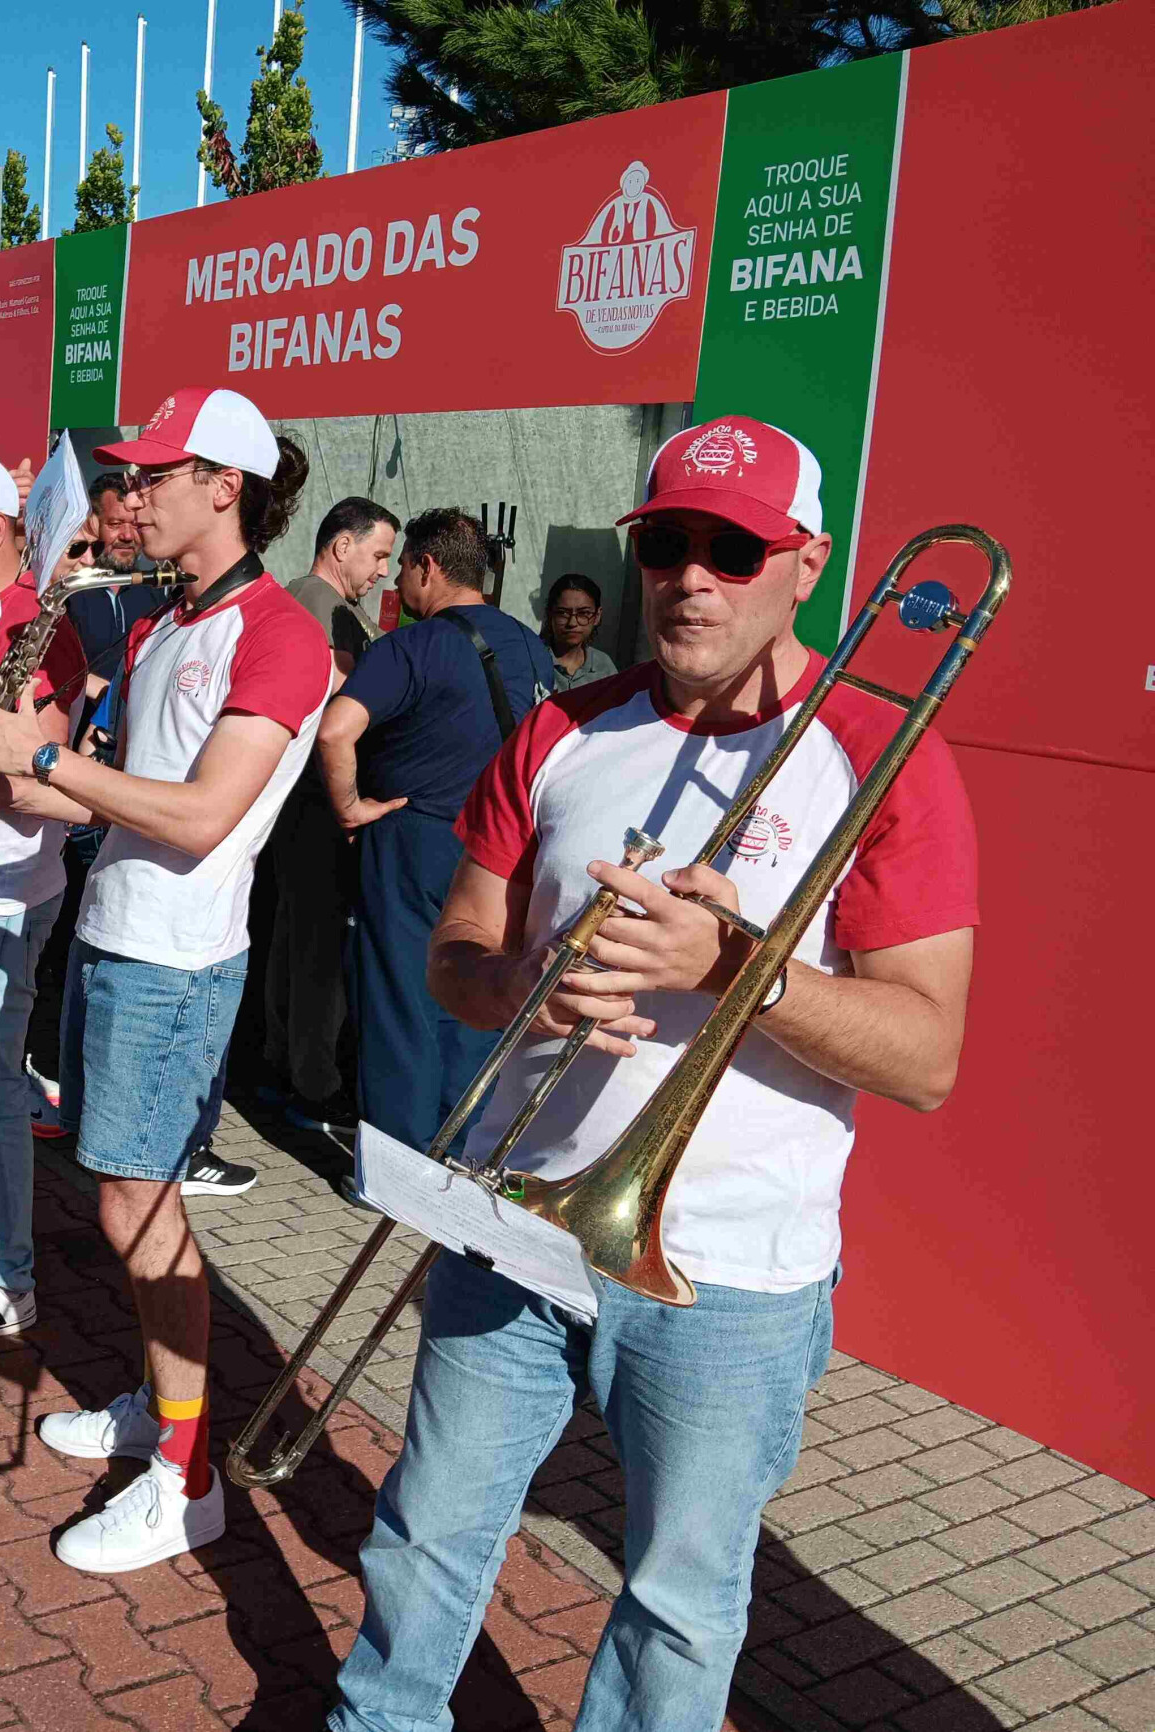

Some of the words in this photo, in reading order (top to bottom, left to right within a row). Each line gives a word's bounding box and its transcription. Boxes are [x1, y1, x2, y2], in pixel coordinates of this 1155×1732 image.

[764, 154, 849, 187] TROQUE
[744, 191, 793, 219] AQUI
[797, 189, 812, 211] A
[818, 182, 862, 208] SUA
[747, 217, 817, 246] SENHA
[824, 212, 853, 236] DE
[185, 226, 373, 306] MERCADO
[383, 207, 481, 276] DAS
[564, 238, 689, 305] BIFANAS
[730, 245, 863, 292] BIFANA
[77, 284, 108, 302] TROQUE
[744, 301, 757, 321] E
[762, 293, 839, 320] BEBIDA
[69, 305, 87, 320] AQUI
[88, 304, 94, 317] A
[95, 302, 112, 317] SUA
[71, 322, 96, 337] SENHA
[97, 320, 108, 334] DE
[228, 303, 403, 372] BIFANAS
[65, 339, 112, 365] BIFANA
[70, 370, 76, 383] E
[76, 368, 103, 383] BEBIDA
